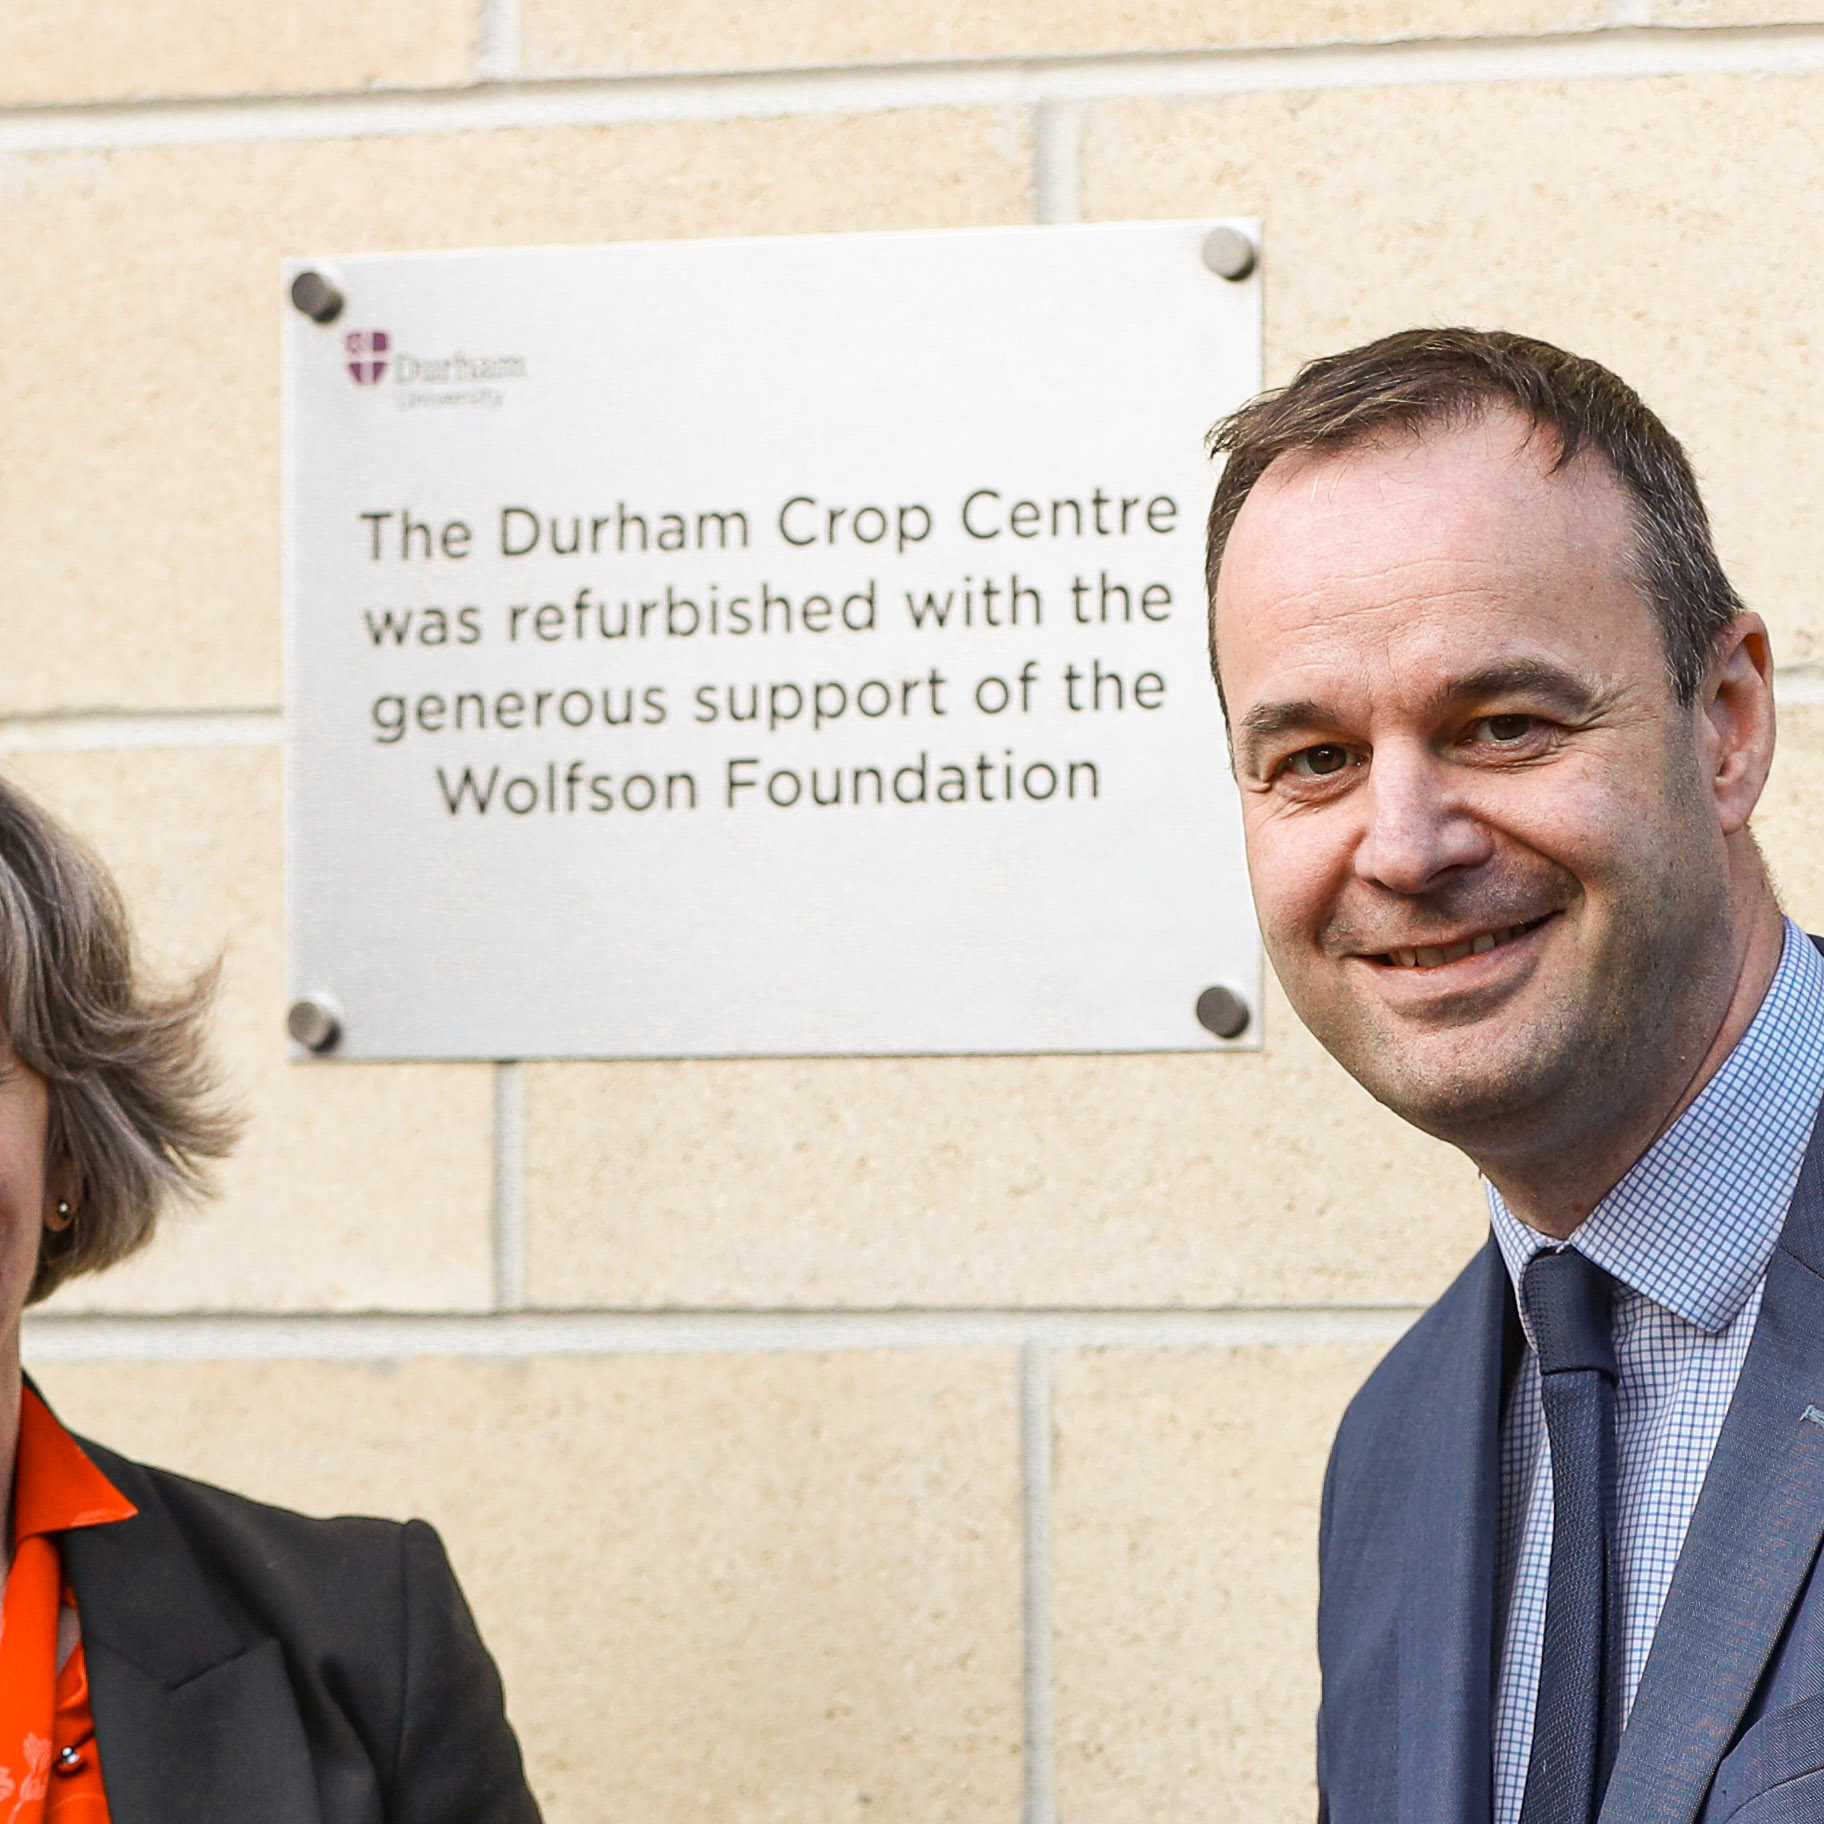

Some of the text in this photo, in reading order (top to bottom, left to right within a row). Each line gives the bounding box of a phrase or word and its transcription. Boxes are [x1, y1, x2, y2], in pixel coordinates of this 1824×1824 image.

[394, 348, 527, 383] Durham
[361, 489, 1178, 559] The Durham Crop Centre
[366, 572, 1172, 646] was refurbished with the
[372, 660, 1165, 744] generous support of the
[437, 750, 1099, 815] Wolfson Foundation
